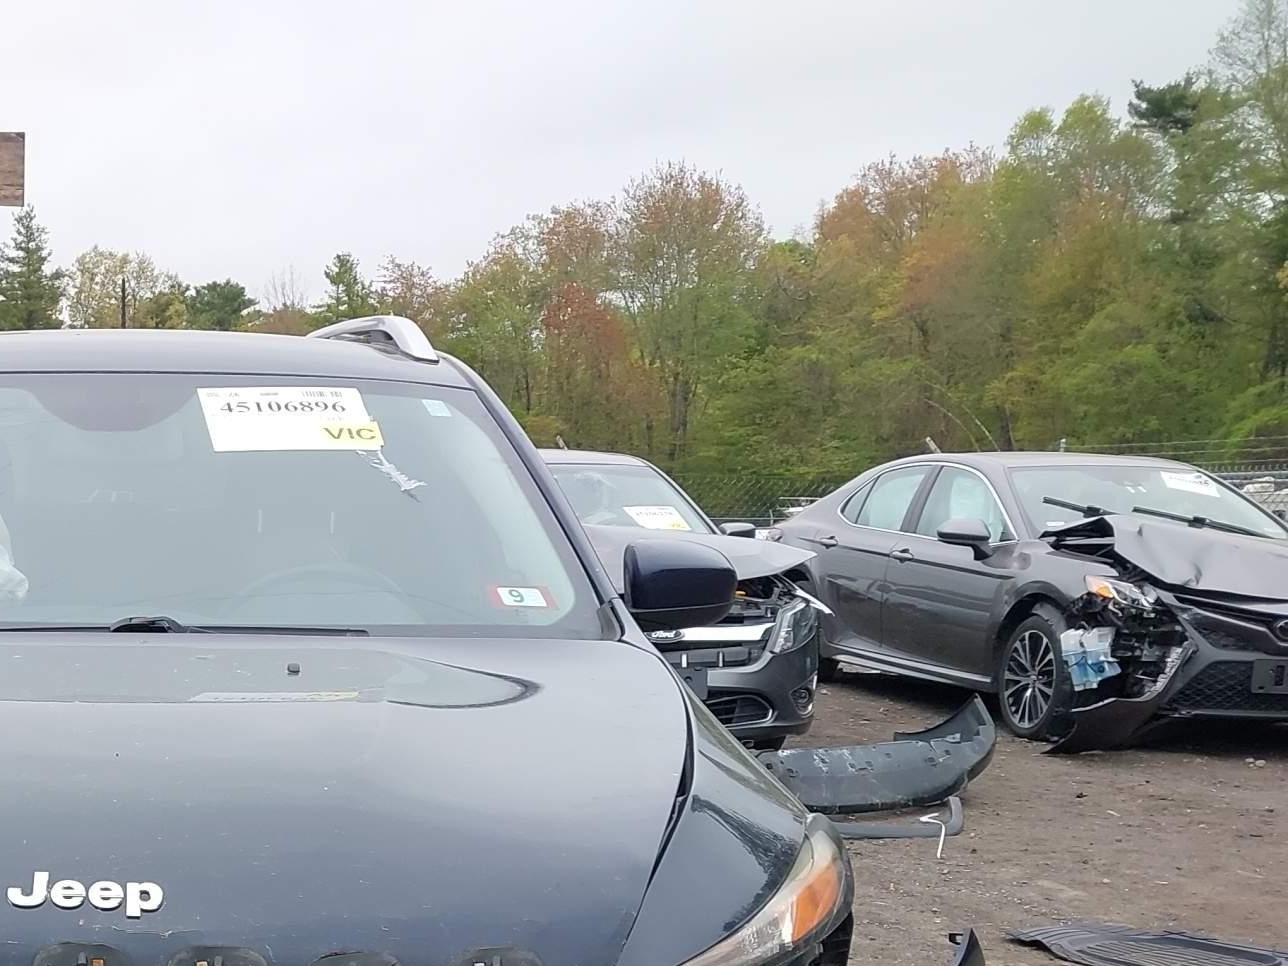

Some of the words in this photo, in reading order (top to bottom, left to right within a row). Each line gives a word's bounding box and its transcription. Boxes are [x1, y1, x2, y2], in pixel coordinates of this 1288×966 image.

[220, 400, 346, 413] 45106896
[323, 427, 377, 440] VIC
[508, 589, 524, 603] 9
[7, 871, 164, 919] Jeep
